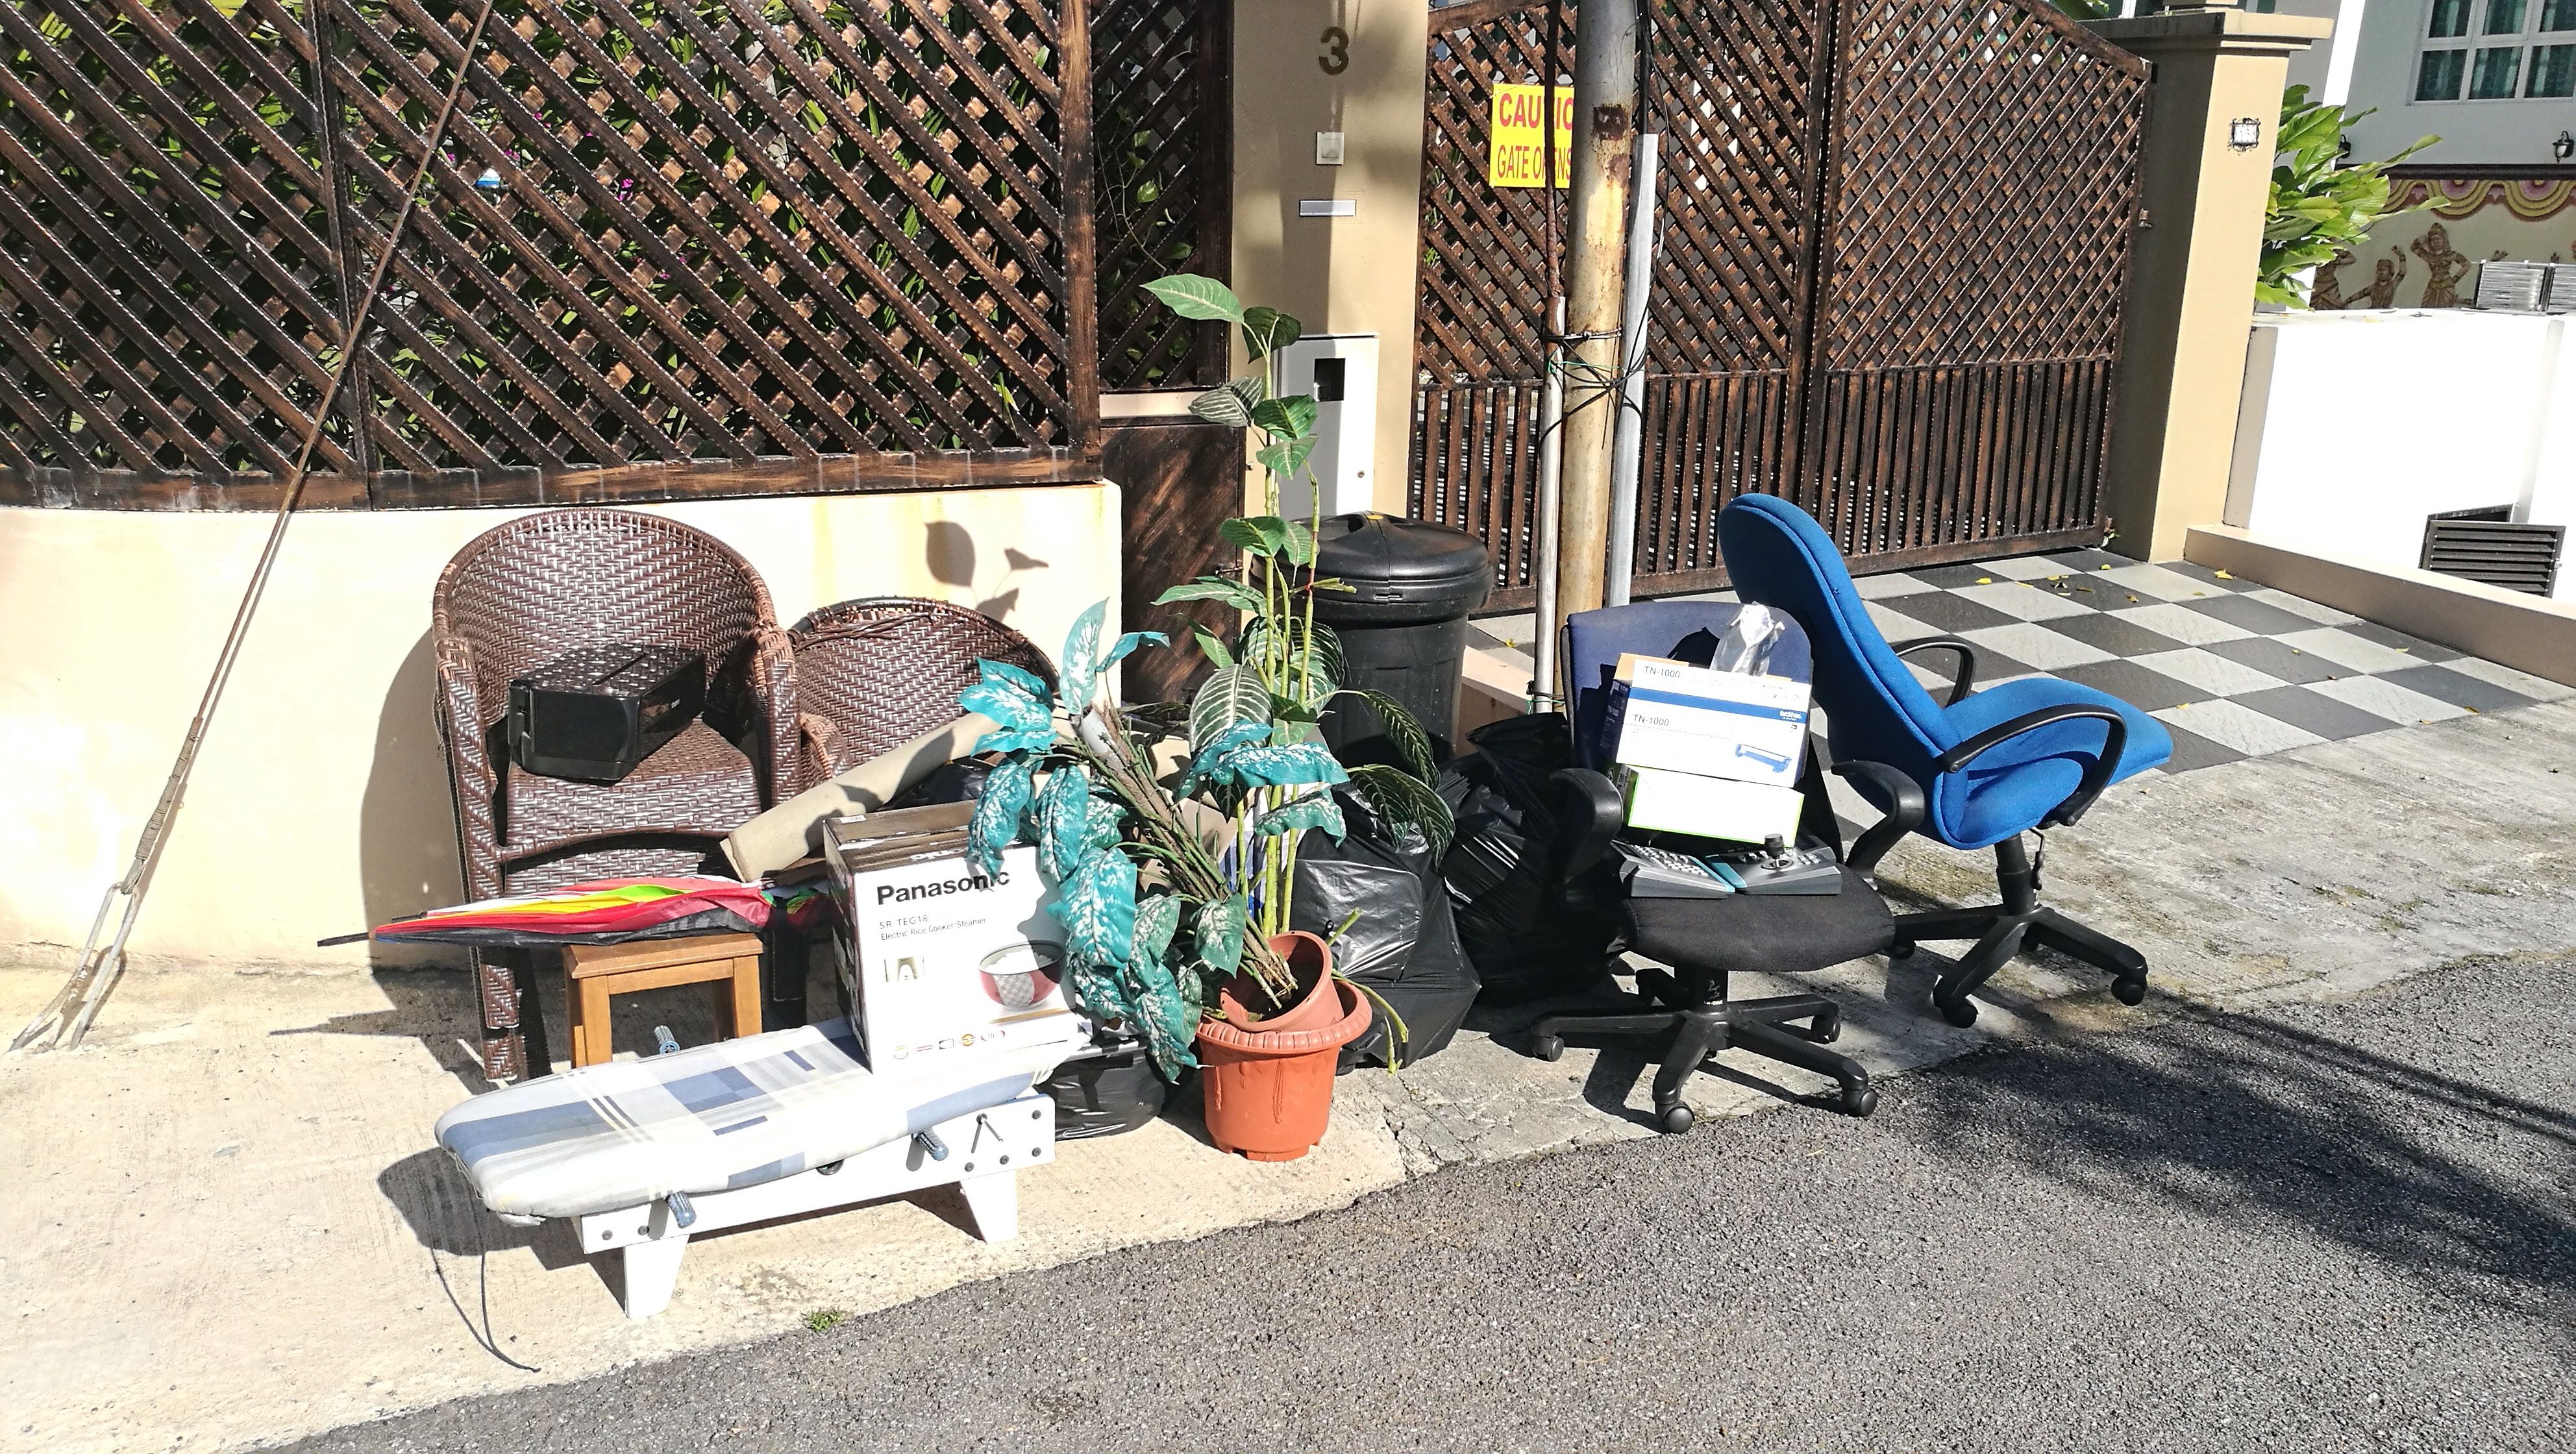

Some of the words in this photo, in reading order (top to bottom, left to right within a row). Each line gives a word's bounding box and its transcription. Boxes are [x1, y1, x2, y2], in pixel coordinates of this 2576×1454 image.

[1319, 27, 1349, 75] 3
[1500, 93, 1574, 130] CAUIO
[1498, 144, 1530, 179] GATE
[1644, 665, 1680, 678] TN-1000
[1633, 714, 1669, 726] TN-1000
[881, 930, 908, 941] Electric
[910, 925, 926, 935] Rice
